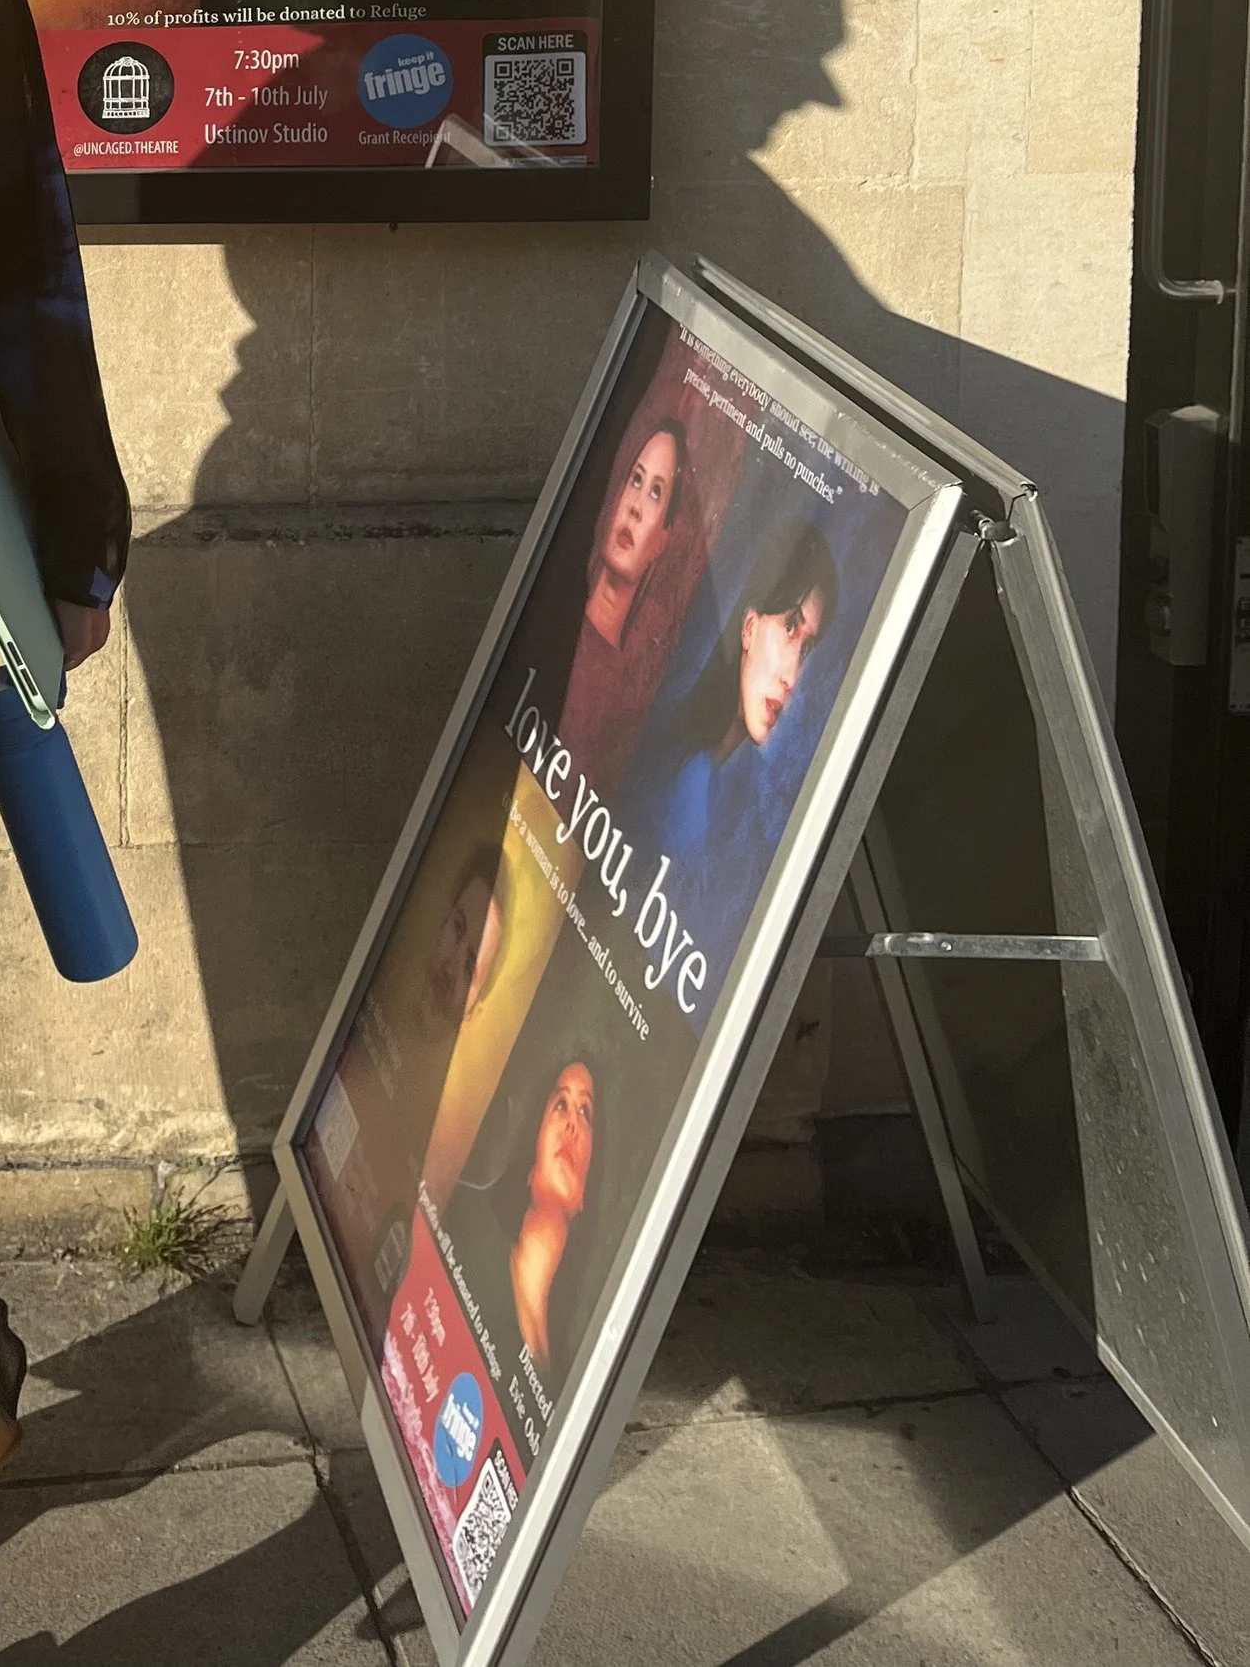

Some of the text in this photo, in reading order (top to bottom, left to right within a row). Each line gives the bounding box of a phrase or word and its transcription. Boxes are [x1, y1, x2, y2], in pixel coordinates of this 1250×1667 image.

[106, 3, 427, 28] 10% of profits will be donated to Refuge
[497, 33, 575, 52] SCAN HERE
[233, 49, 299, 74] 7:30pm
[398, 54, 425, 69] keep
[363, 61, 447, 101] fringe
[205, 87, 233, 107] 7th
[251, 85, 291, 107] 10th
[294, 84, 329, 111] July
[205, 122, 328, 145] Ustinov Studio
[358, 130, 390, 145] Grant
[73, 140, 180, 158] @UNCAGED.THEATRE
[708, 390, 747, 429] pertinent
[745, 419, 766, 443] and
[760, 433, 785, 460] pulls
[783, 451, 797, 470] no
[504, 667, 708, 1015] love you, bye
[549, 865, 560, 891] is
[556, 882, 569, 905] to
[587, 935, 610, 971] and
[604, 960, 617, 985] to
[614, 979, 650, 1041] survive
[518, 1343, 553, 1422] Directed
[508, 1374, 526, 1420] Evie
